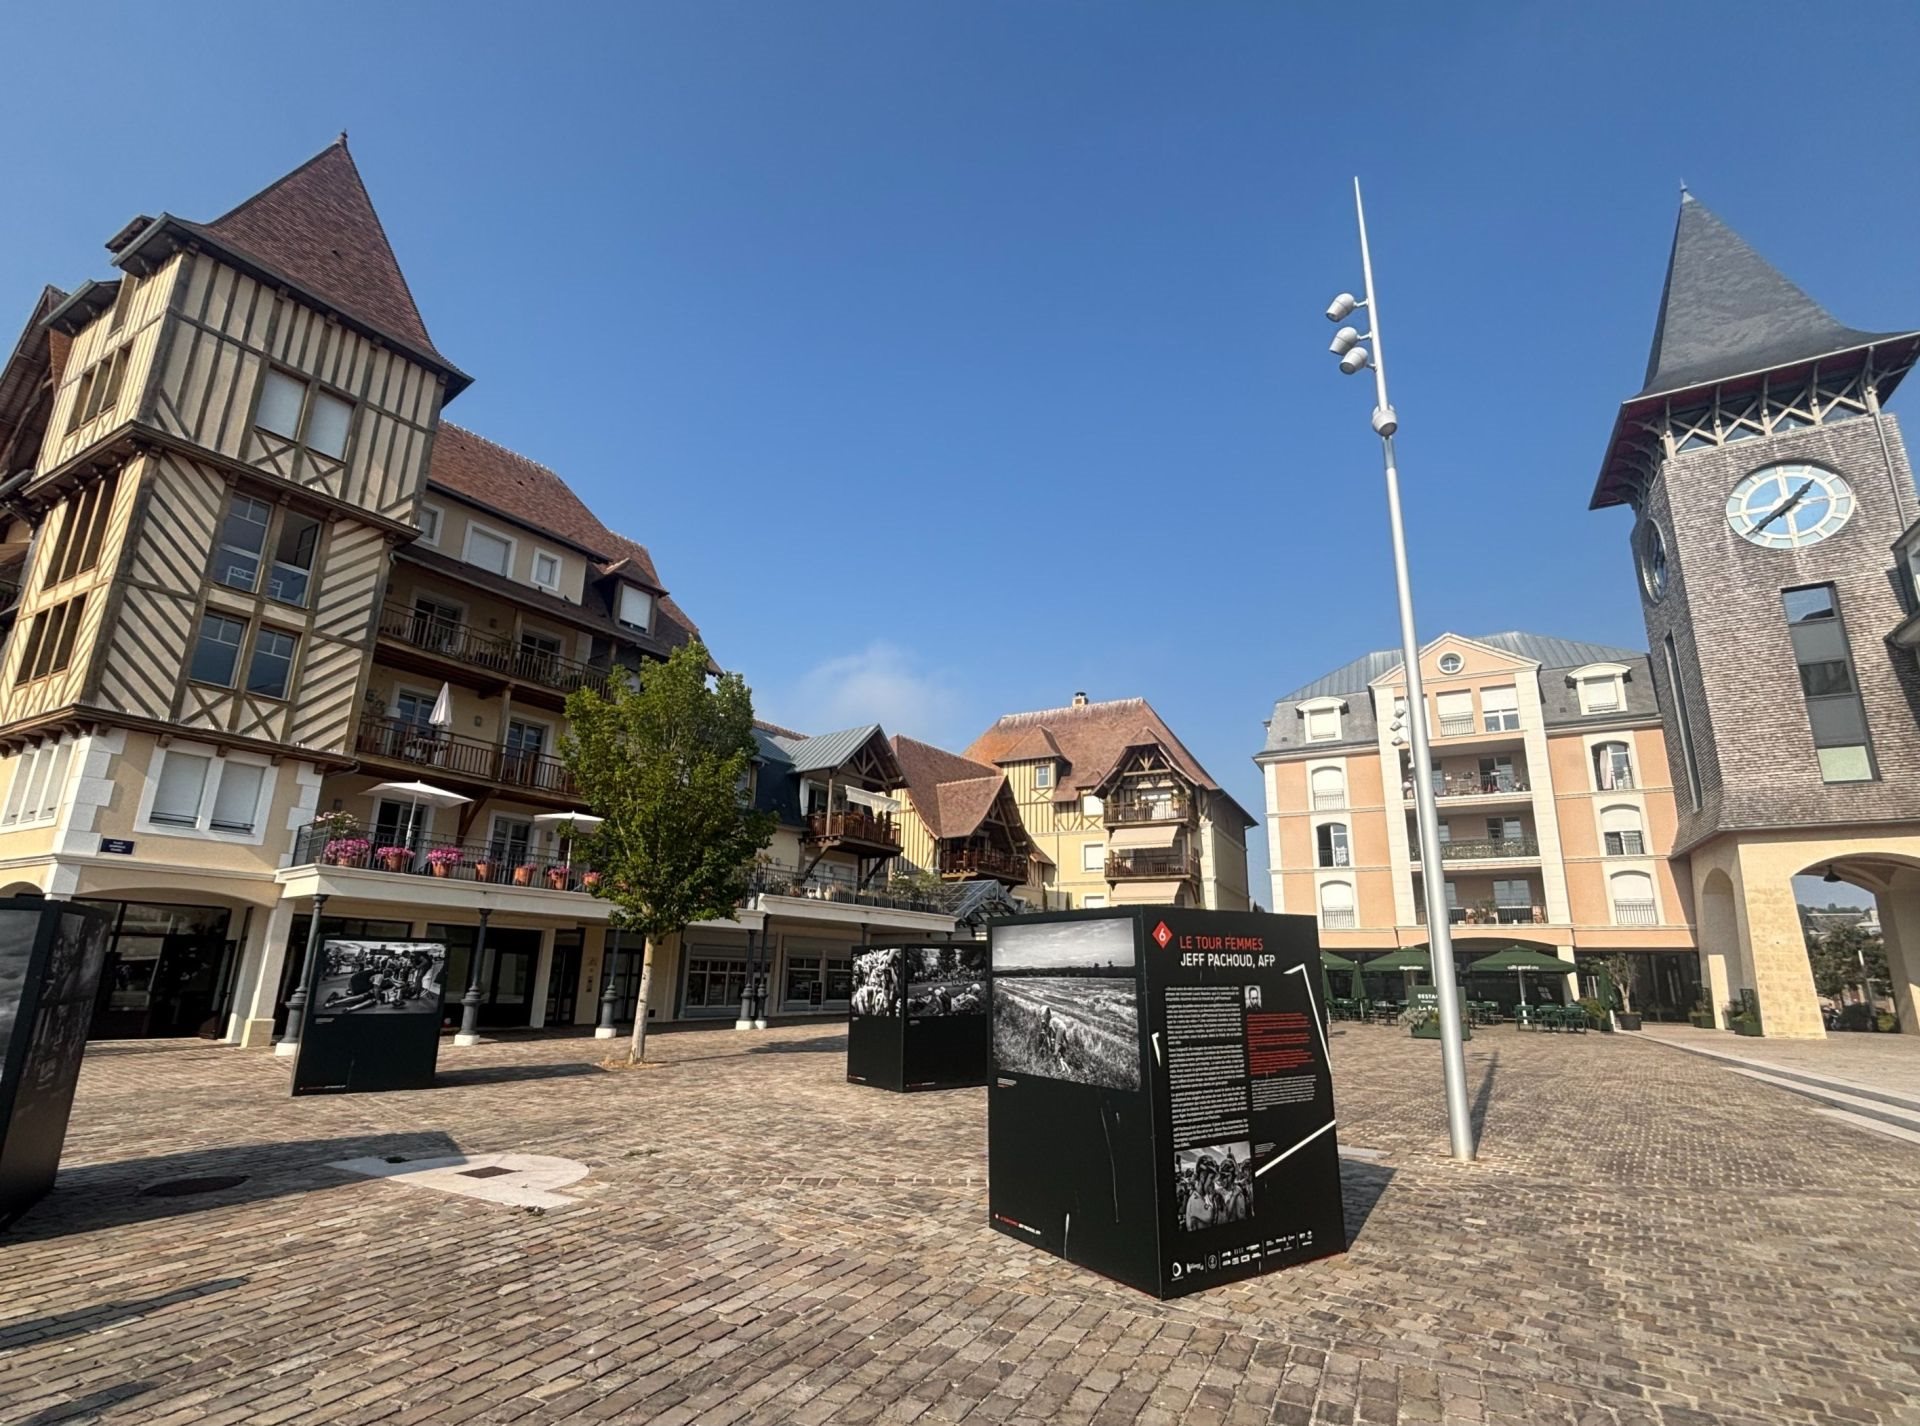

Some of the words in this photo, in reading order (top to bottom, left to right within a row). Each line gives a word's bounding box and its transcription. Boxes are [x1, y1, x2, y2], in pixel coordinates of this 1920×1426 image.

[1159, 928, 1166, 941] 6
[1180, 936, 1192, 949] LE
[1195, 936, 1222, 949] TOUR
[1225, 937, 1264, 951] FEMMES
[1180, 953, 1205, 966] JEFF
[1208, 953, 1255, 968] PACHOUD,
[1258, 954, 1276, 967] AFP
